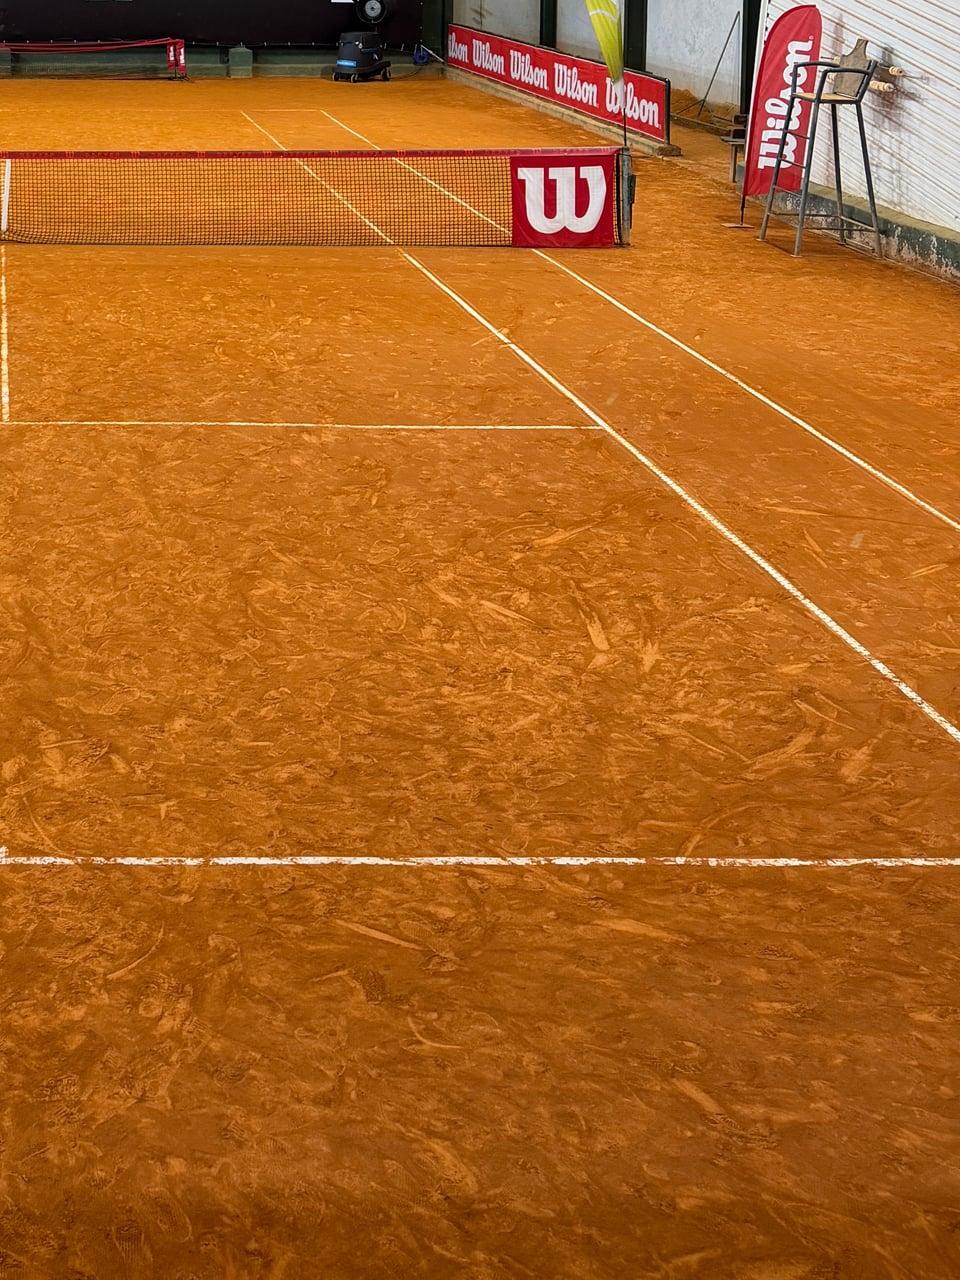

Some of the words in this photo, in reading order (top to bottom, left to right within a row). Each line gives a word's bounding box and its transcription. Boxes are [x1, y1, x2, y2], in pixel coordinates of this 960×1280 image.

[473, 39, 505, 75] Wilson
[510, 50, 548, 90] Wilson
[554, 63, 598, 107] Wilson
[757, 37, 813, 169] Wilson
[517, 165, 607, 234] W
